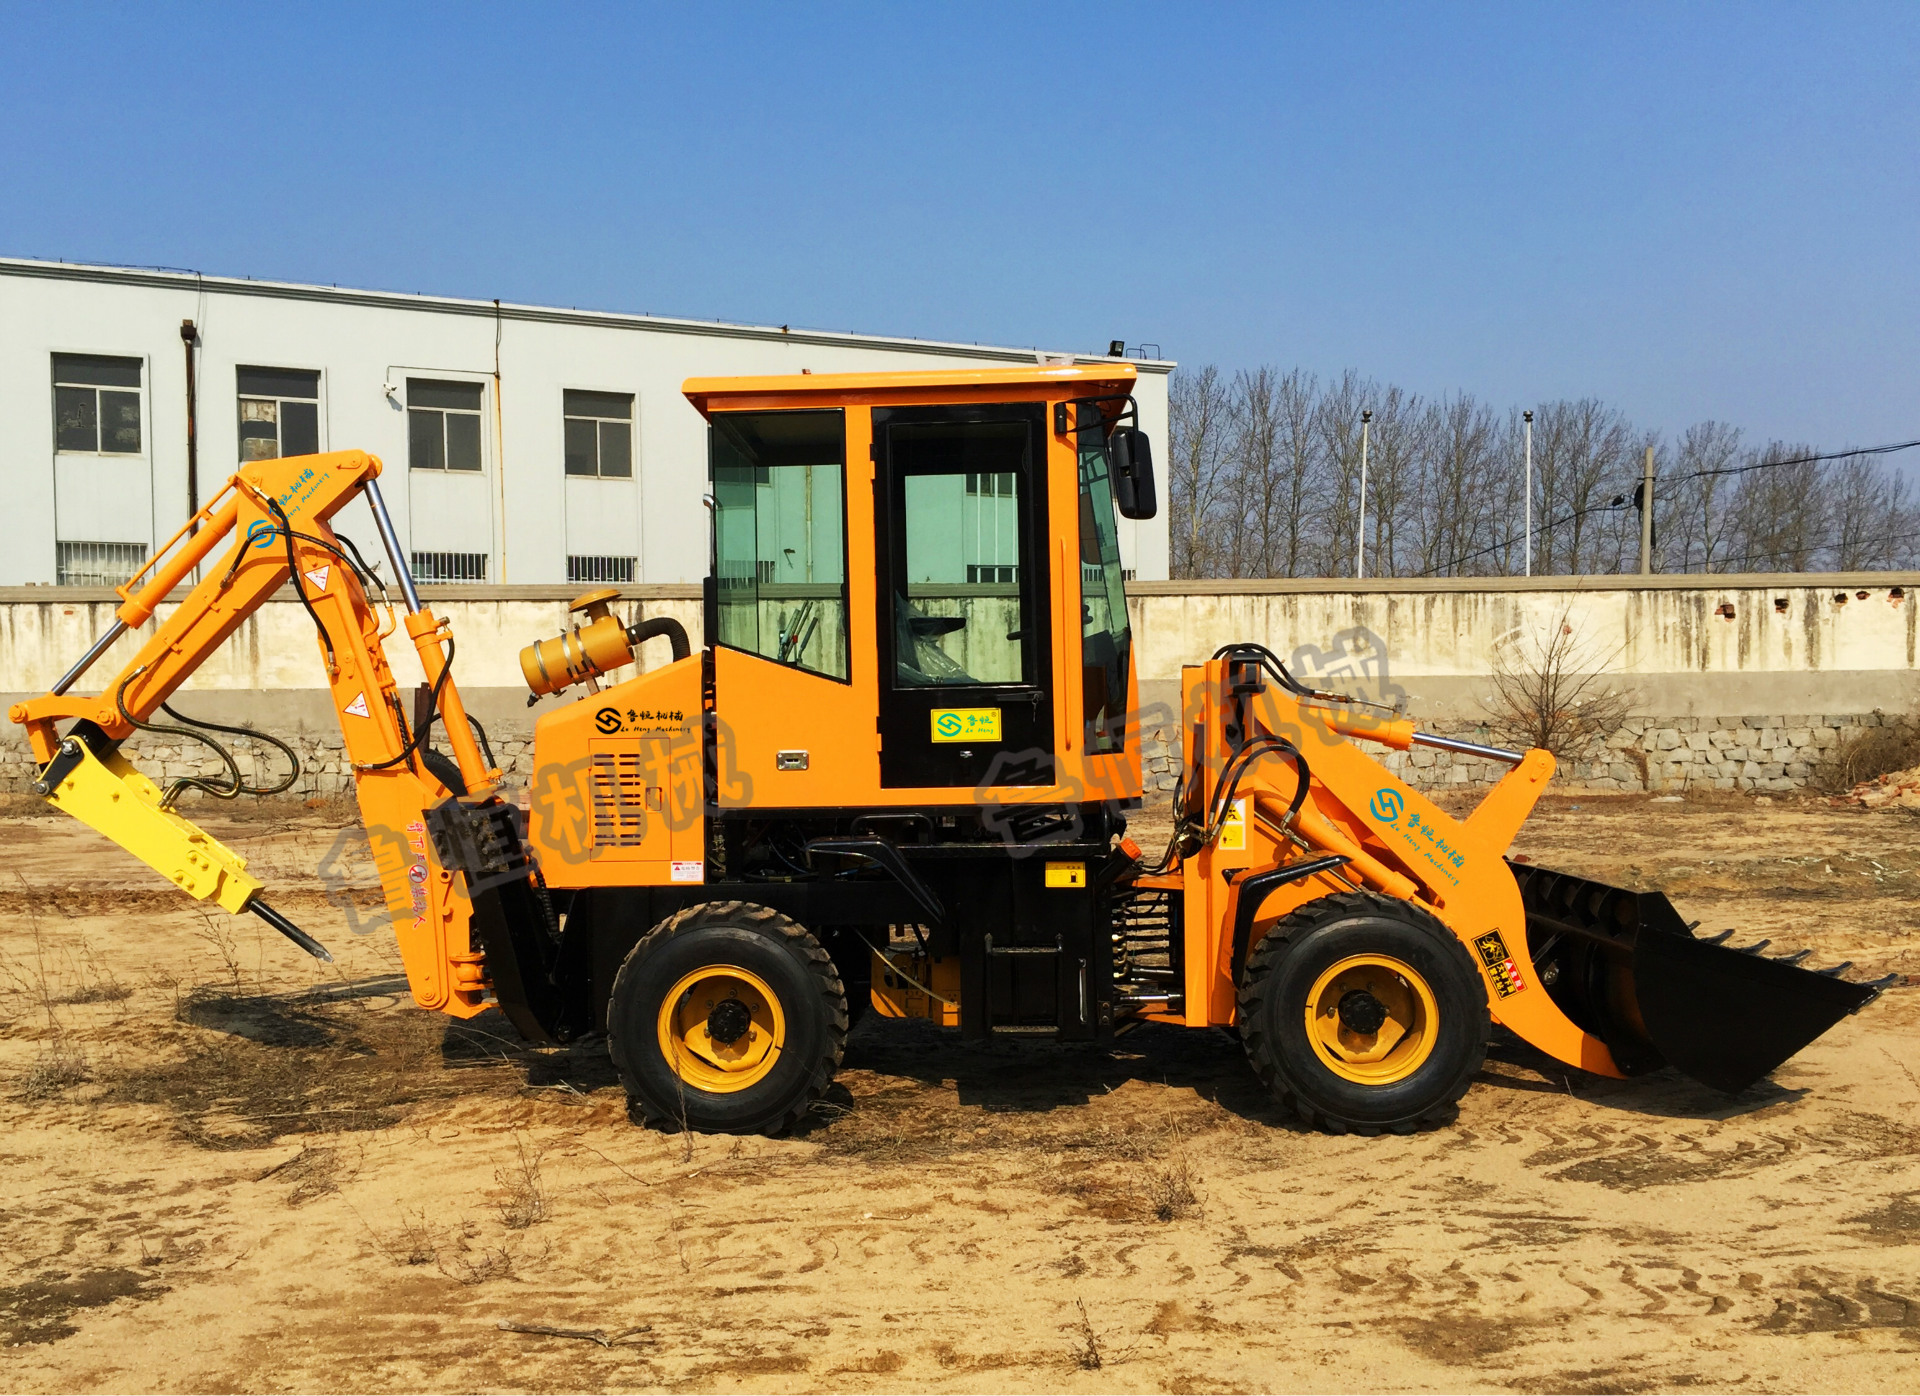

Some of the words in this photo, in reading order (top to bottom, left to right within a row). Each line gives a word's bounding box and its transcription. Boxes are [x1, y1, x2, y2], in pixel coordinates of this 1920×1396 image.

[626, 708, 684, 723] 鲁恒机械
[967, 714, 993, 726] 鲁恒
[633, 726, 650, 734] Heng
[655, 725, 691, 734] Machinery
[977, 727, 994, 735] Heng
[1407, 812, 1465, 869] 鲁恒机械
[1402, 833, 1421, 852] Heng
[1423, 852, 1460, 887] Machinery
